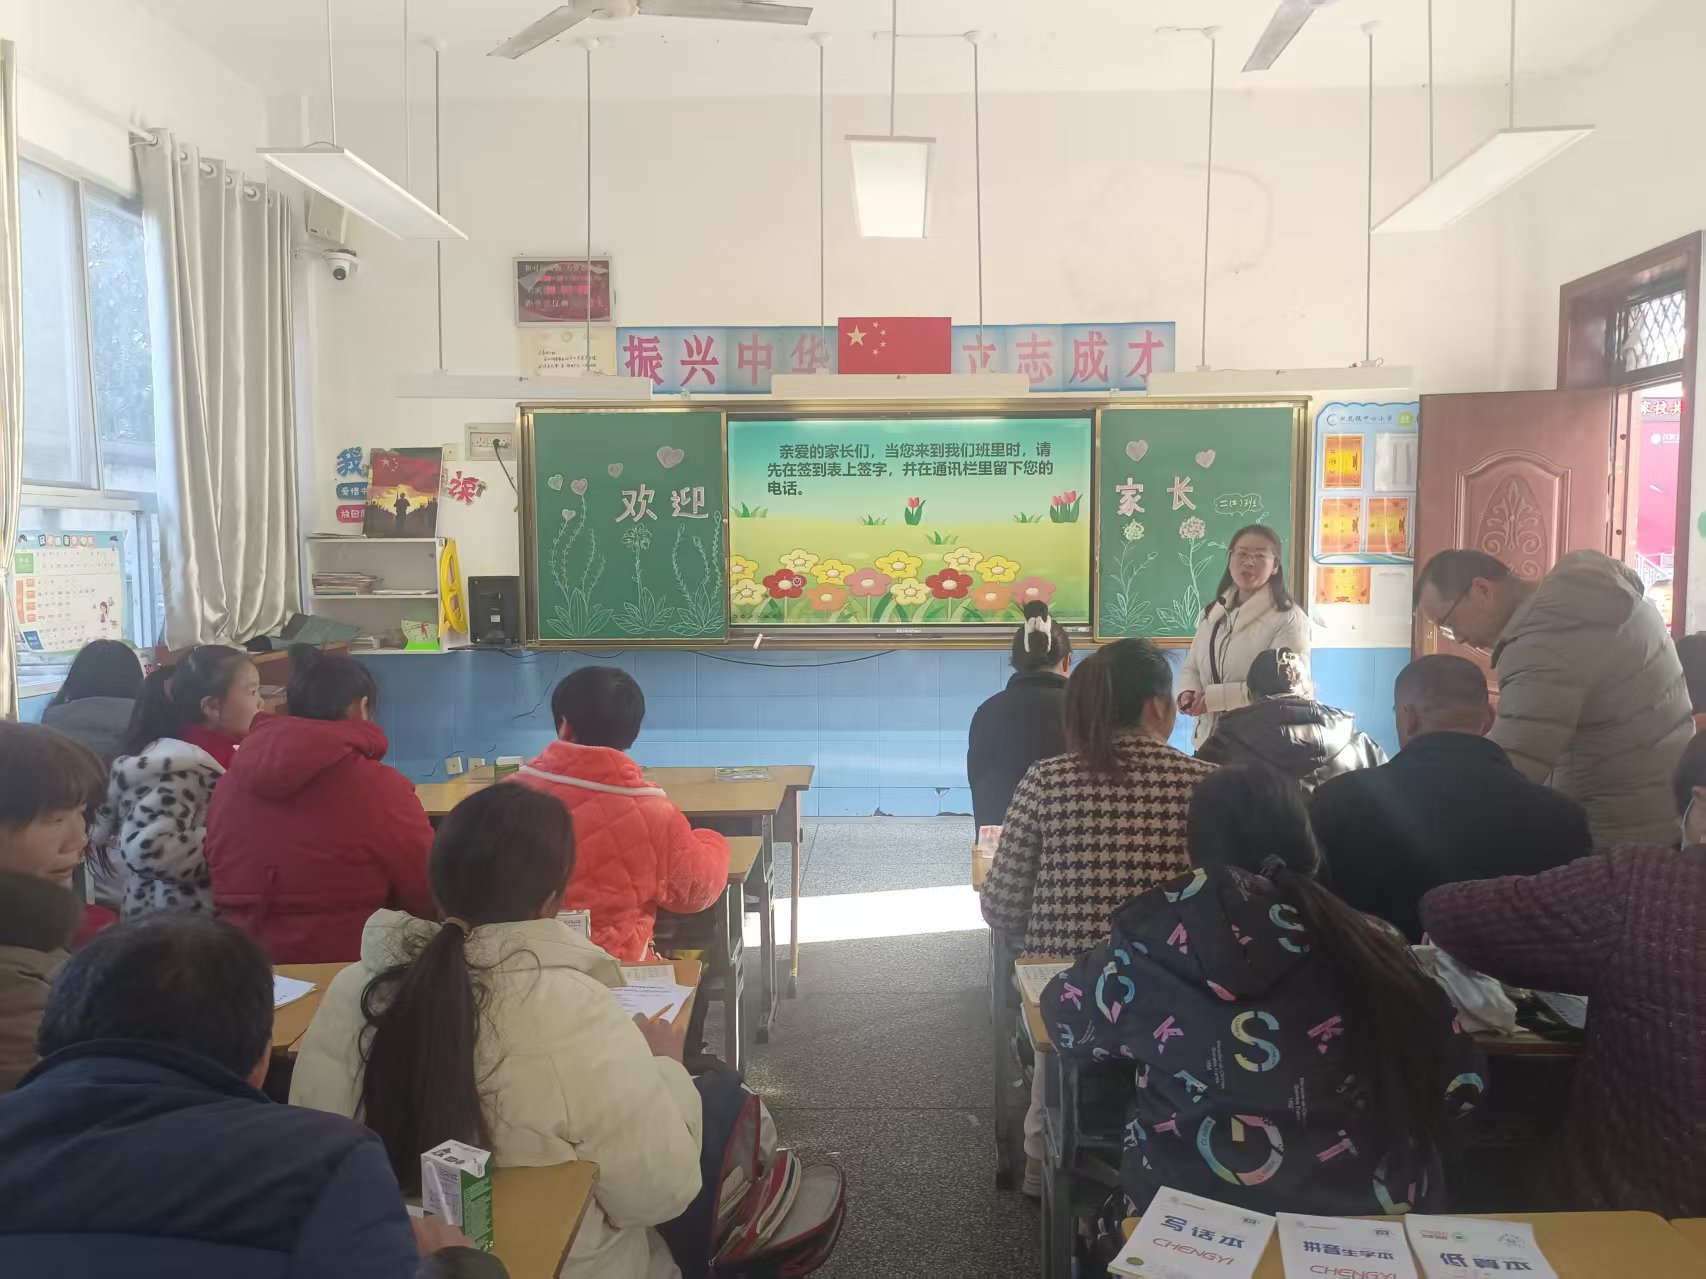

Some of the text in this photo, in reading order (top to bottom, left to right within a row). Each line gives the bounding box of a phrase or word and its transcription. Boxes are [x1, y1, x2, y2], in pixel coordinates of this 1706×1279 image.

[623, 329, 1166, 388] 振兴中华 立志成才
[779, 441, 1052, 460] 亲爱的家长们，当您来到我们班里时，请
[767, 459, 1054, 479] 先在签到表上签字，并在通讯栏里留下您的
[615, 483, 709, 523] 欢迎
[767, 481, 805, 497] 电话。
[1115, 475, 1197, 517] 家长
[1230, 1010, 1280, 1072] S
[1160, 1215, 1246, 1250] 写话本
[1152, 1237, 1236, 1266] CHENGYI
[1302, 1240, 1395, 1260] 拼音生字本
